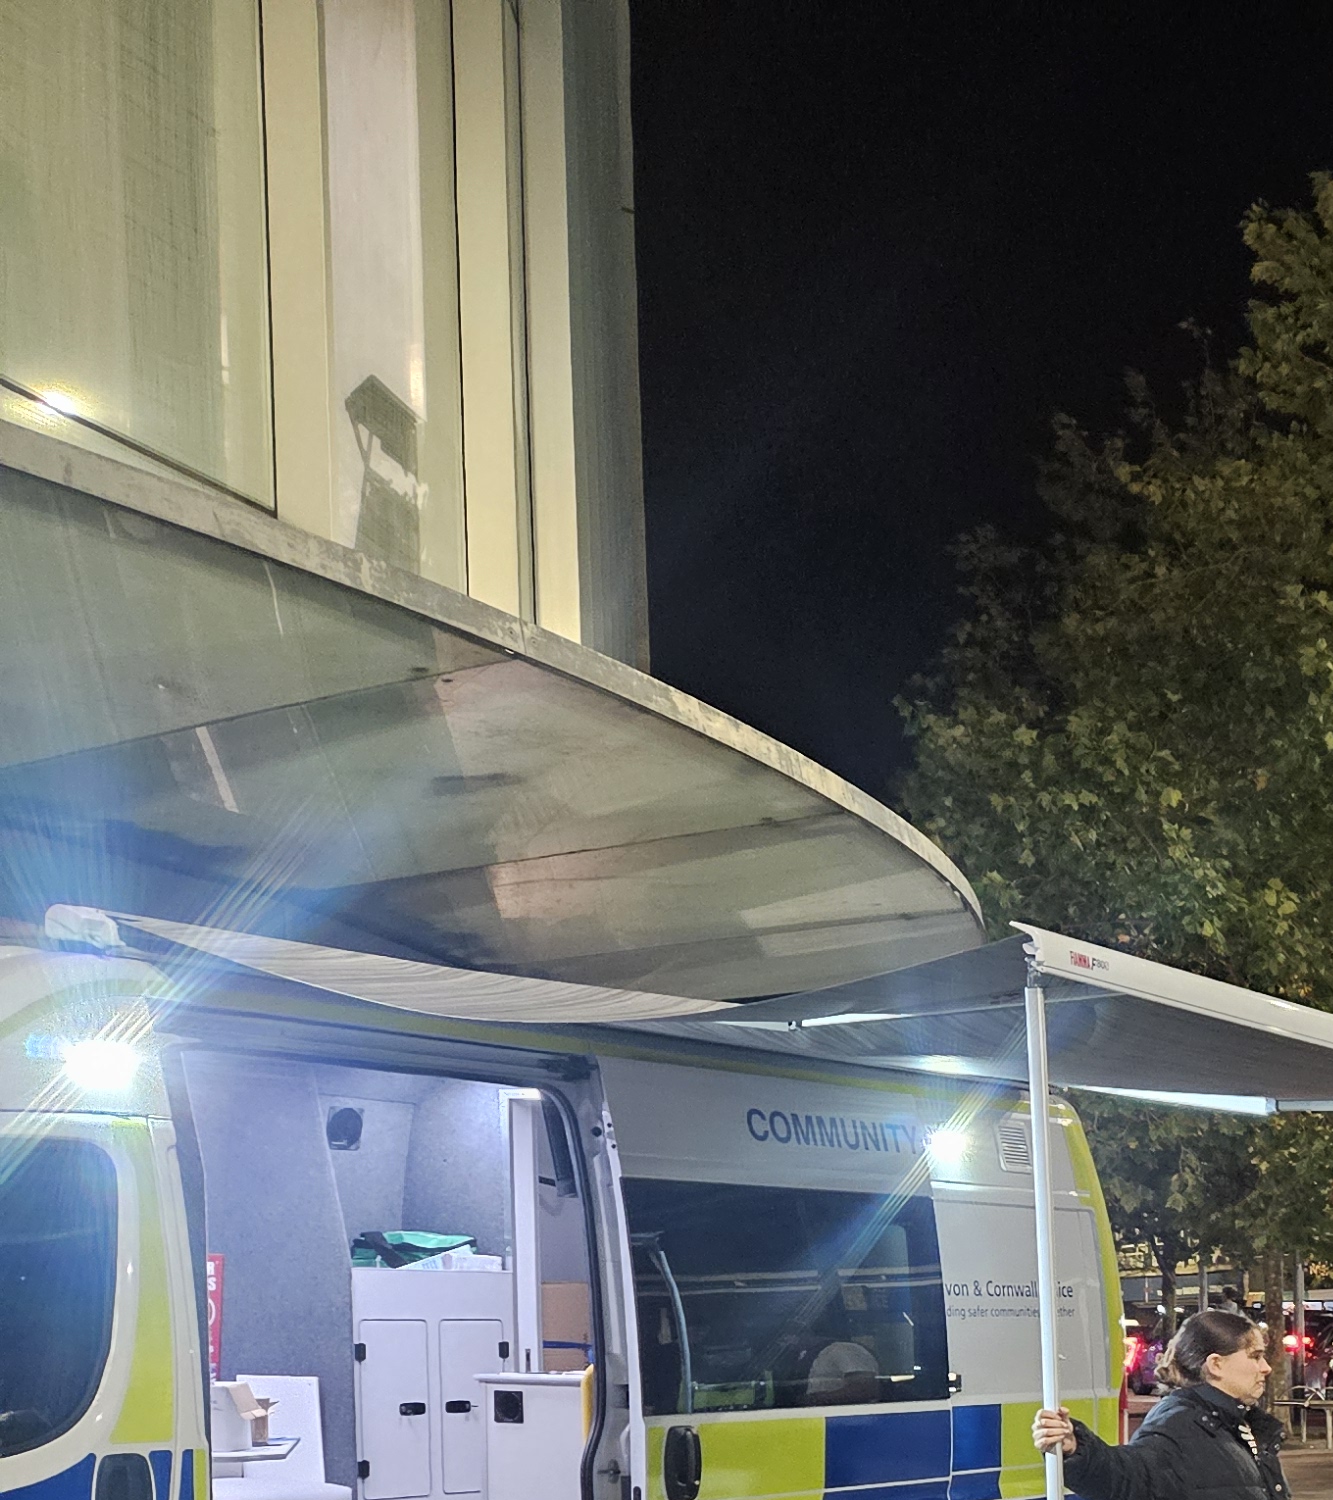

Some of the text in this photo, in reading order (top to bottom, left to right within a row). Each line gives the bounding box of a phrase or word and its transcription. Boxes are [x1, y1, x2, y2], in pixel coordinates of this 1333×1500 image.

[746, 1108, 917, 1154] COMMUNITY
[944, 1280, 1073, 1298] von & Cornwall ice
[946, 1305, 966, 1320] ding
[990, 1305, 1040, 1318] communitie
